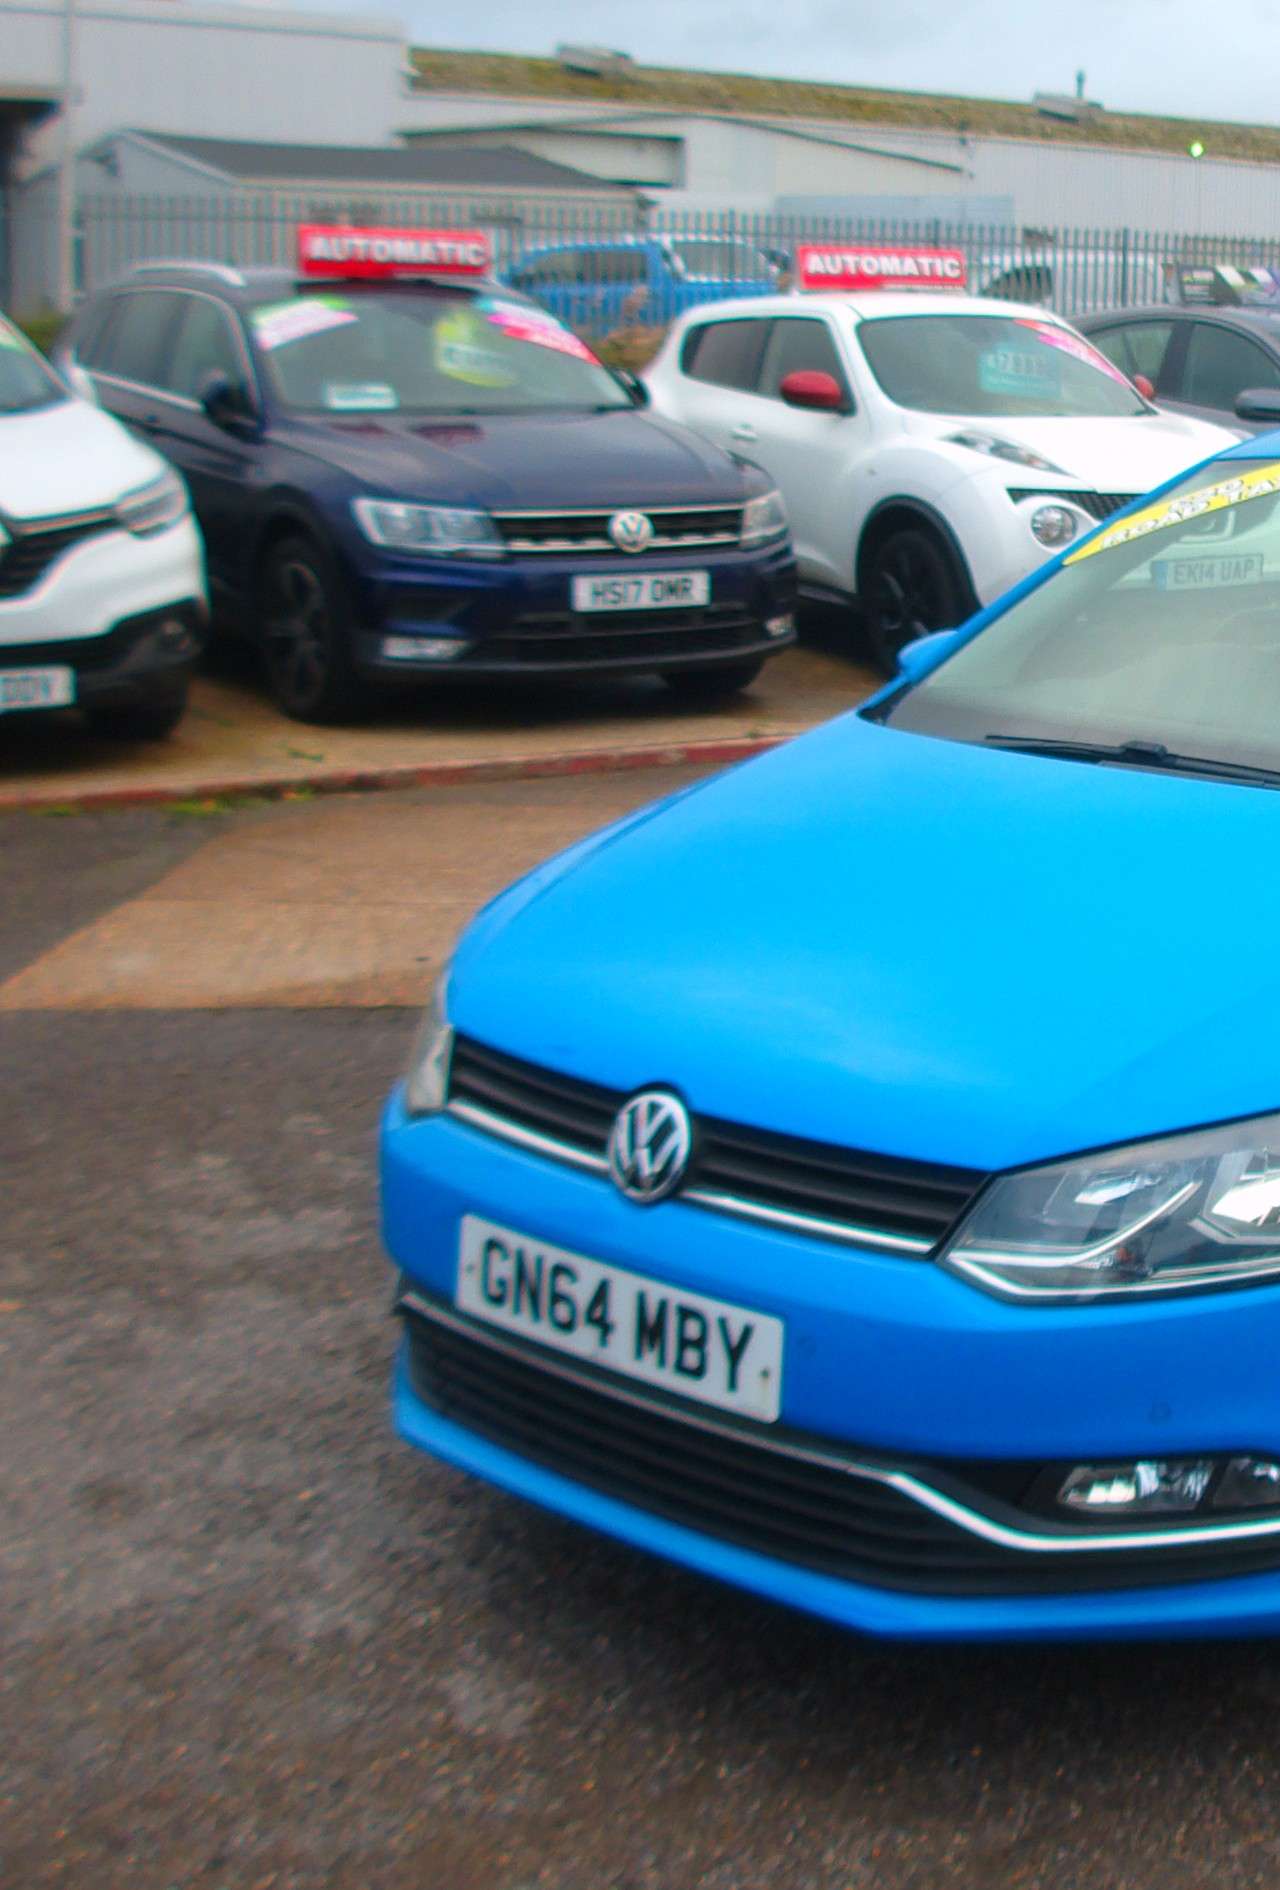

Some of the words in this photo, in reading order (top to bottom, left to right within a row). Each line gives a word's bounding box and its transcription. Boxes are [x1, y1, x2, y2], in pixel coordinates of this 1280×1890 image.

[309, 236, 485, 265] AUTOMATIC
[808, 253, 961, 278] AUTOMATIC
[1174, 561, 1216, 585] EK14
[1219, 558, 1253, 581] UAP
[591, 579, 643, 605] HS17
[480, 1236, 615, 1349] GN64
[634, 1289, 754, 1393] MBY
